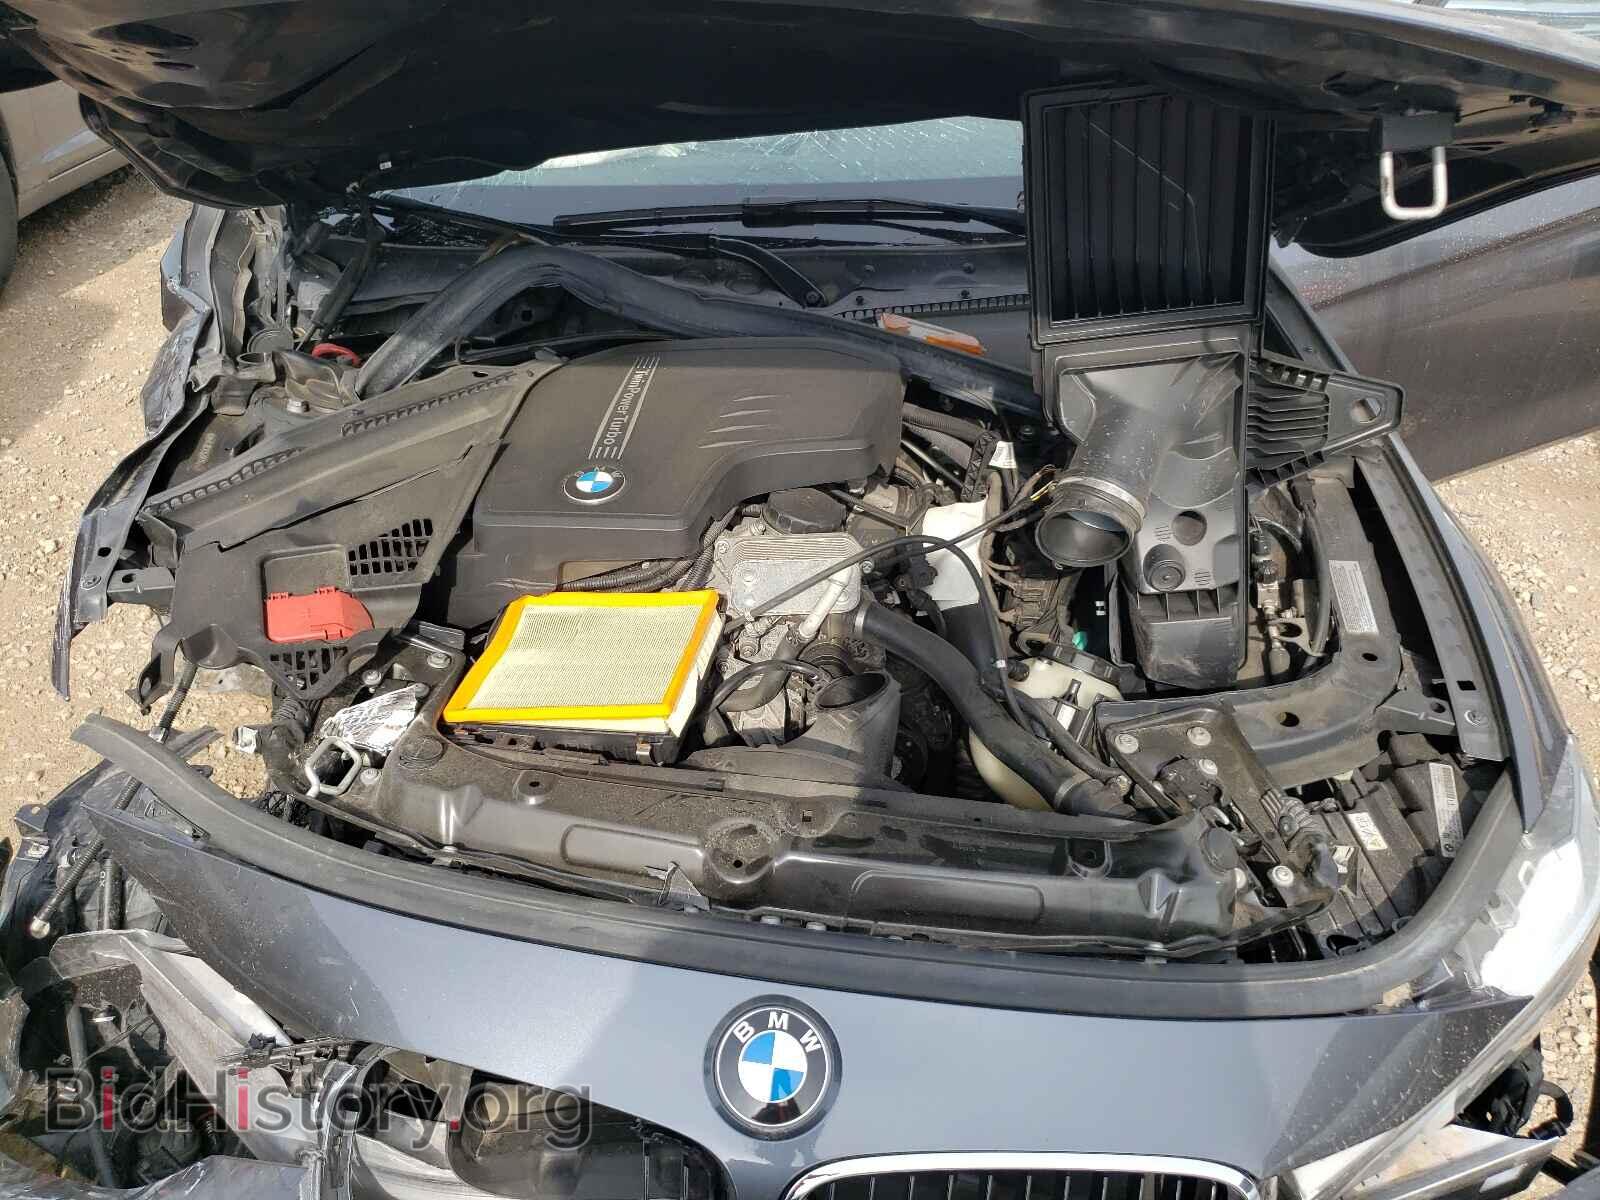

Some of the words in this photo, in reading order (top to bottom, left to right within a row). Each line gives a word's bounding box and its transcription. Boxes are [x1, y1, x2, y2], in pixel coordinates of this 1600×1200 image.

[617, 368, 649, 415] TwinPower
[603, 416, 629, 445] Turbo
[732, 1011, 822, 1053] BMW
